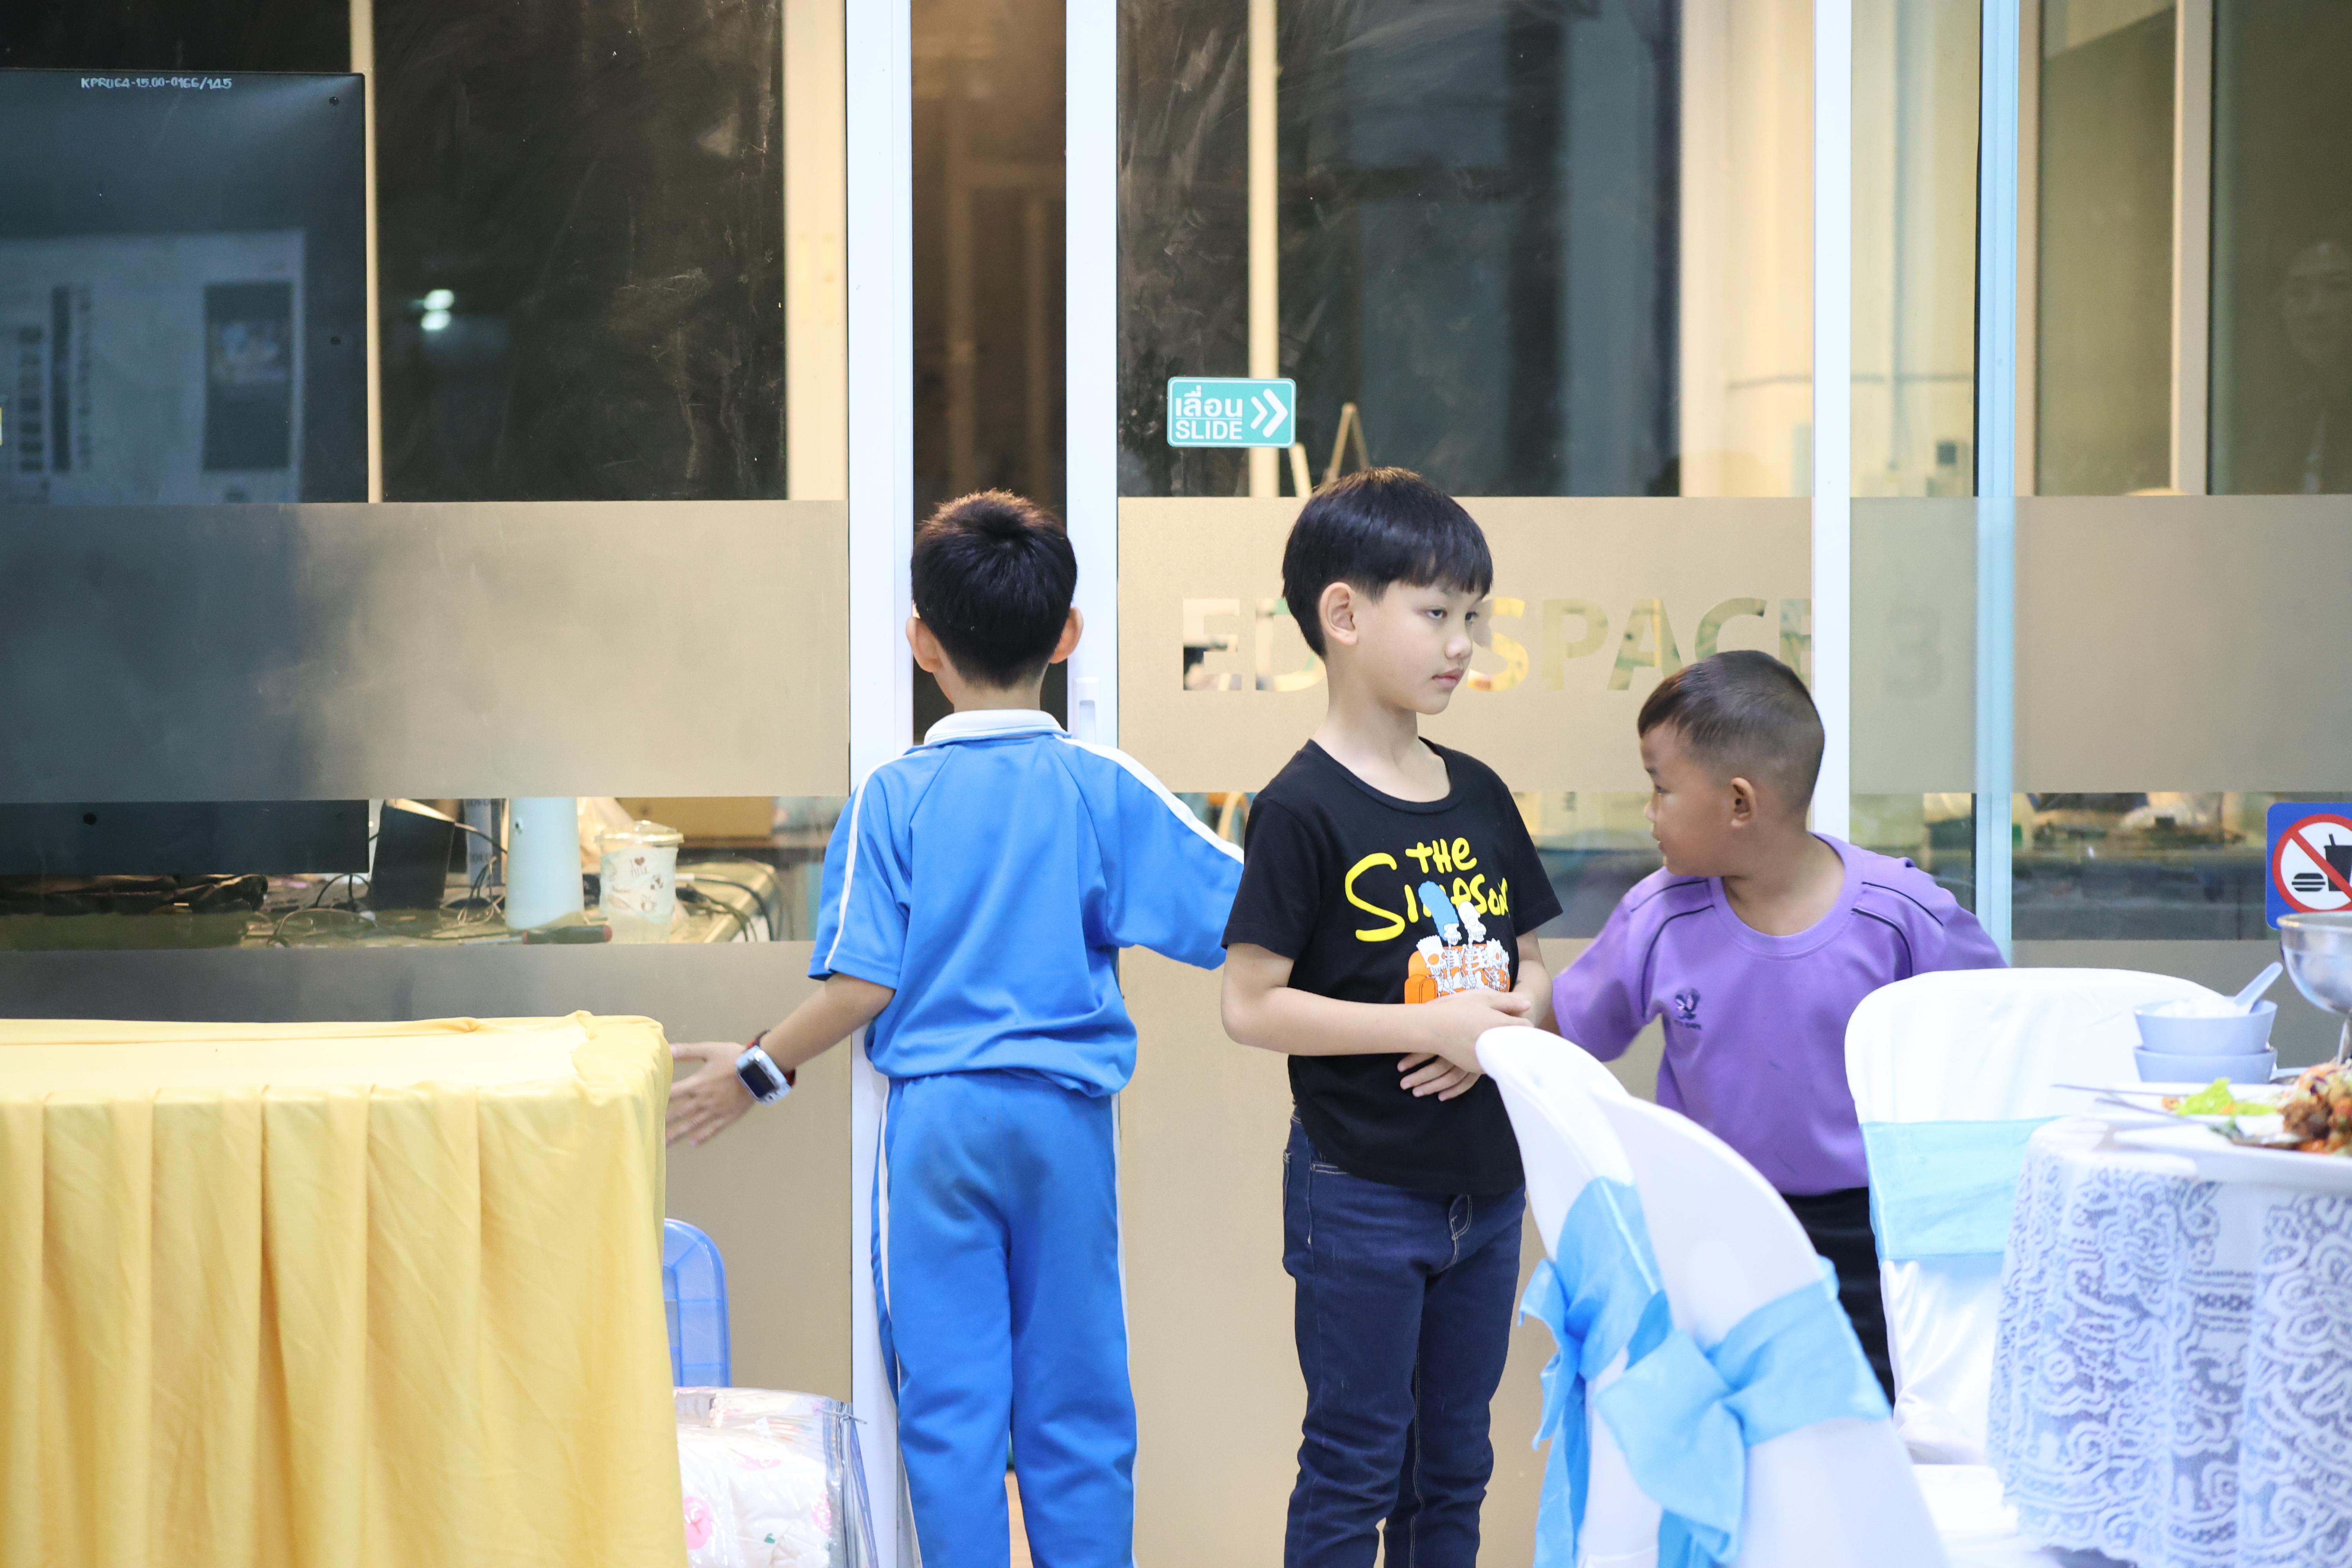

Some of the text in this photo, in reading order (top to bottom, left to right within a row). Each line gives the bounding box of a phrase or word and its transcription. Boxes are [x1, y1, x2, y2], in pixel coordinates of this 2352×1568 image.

[1176, 385, 1243, 417] เลื่อน
[1176, 420, 1242, 439] SLIDE
[1183, 598, 1328, 691] ED
